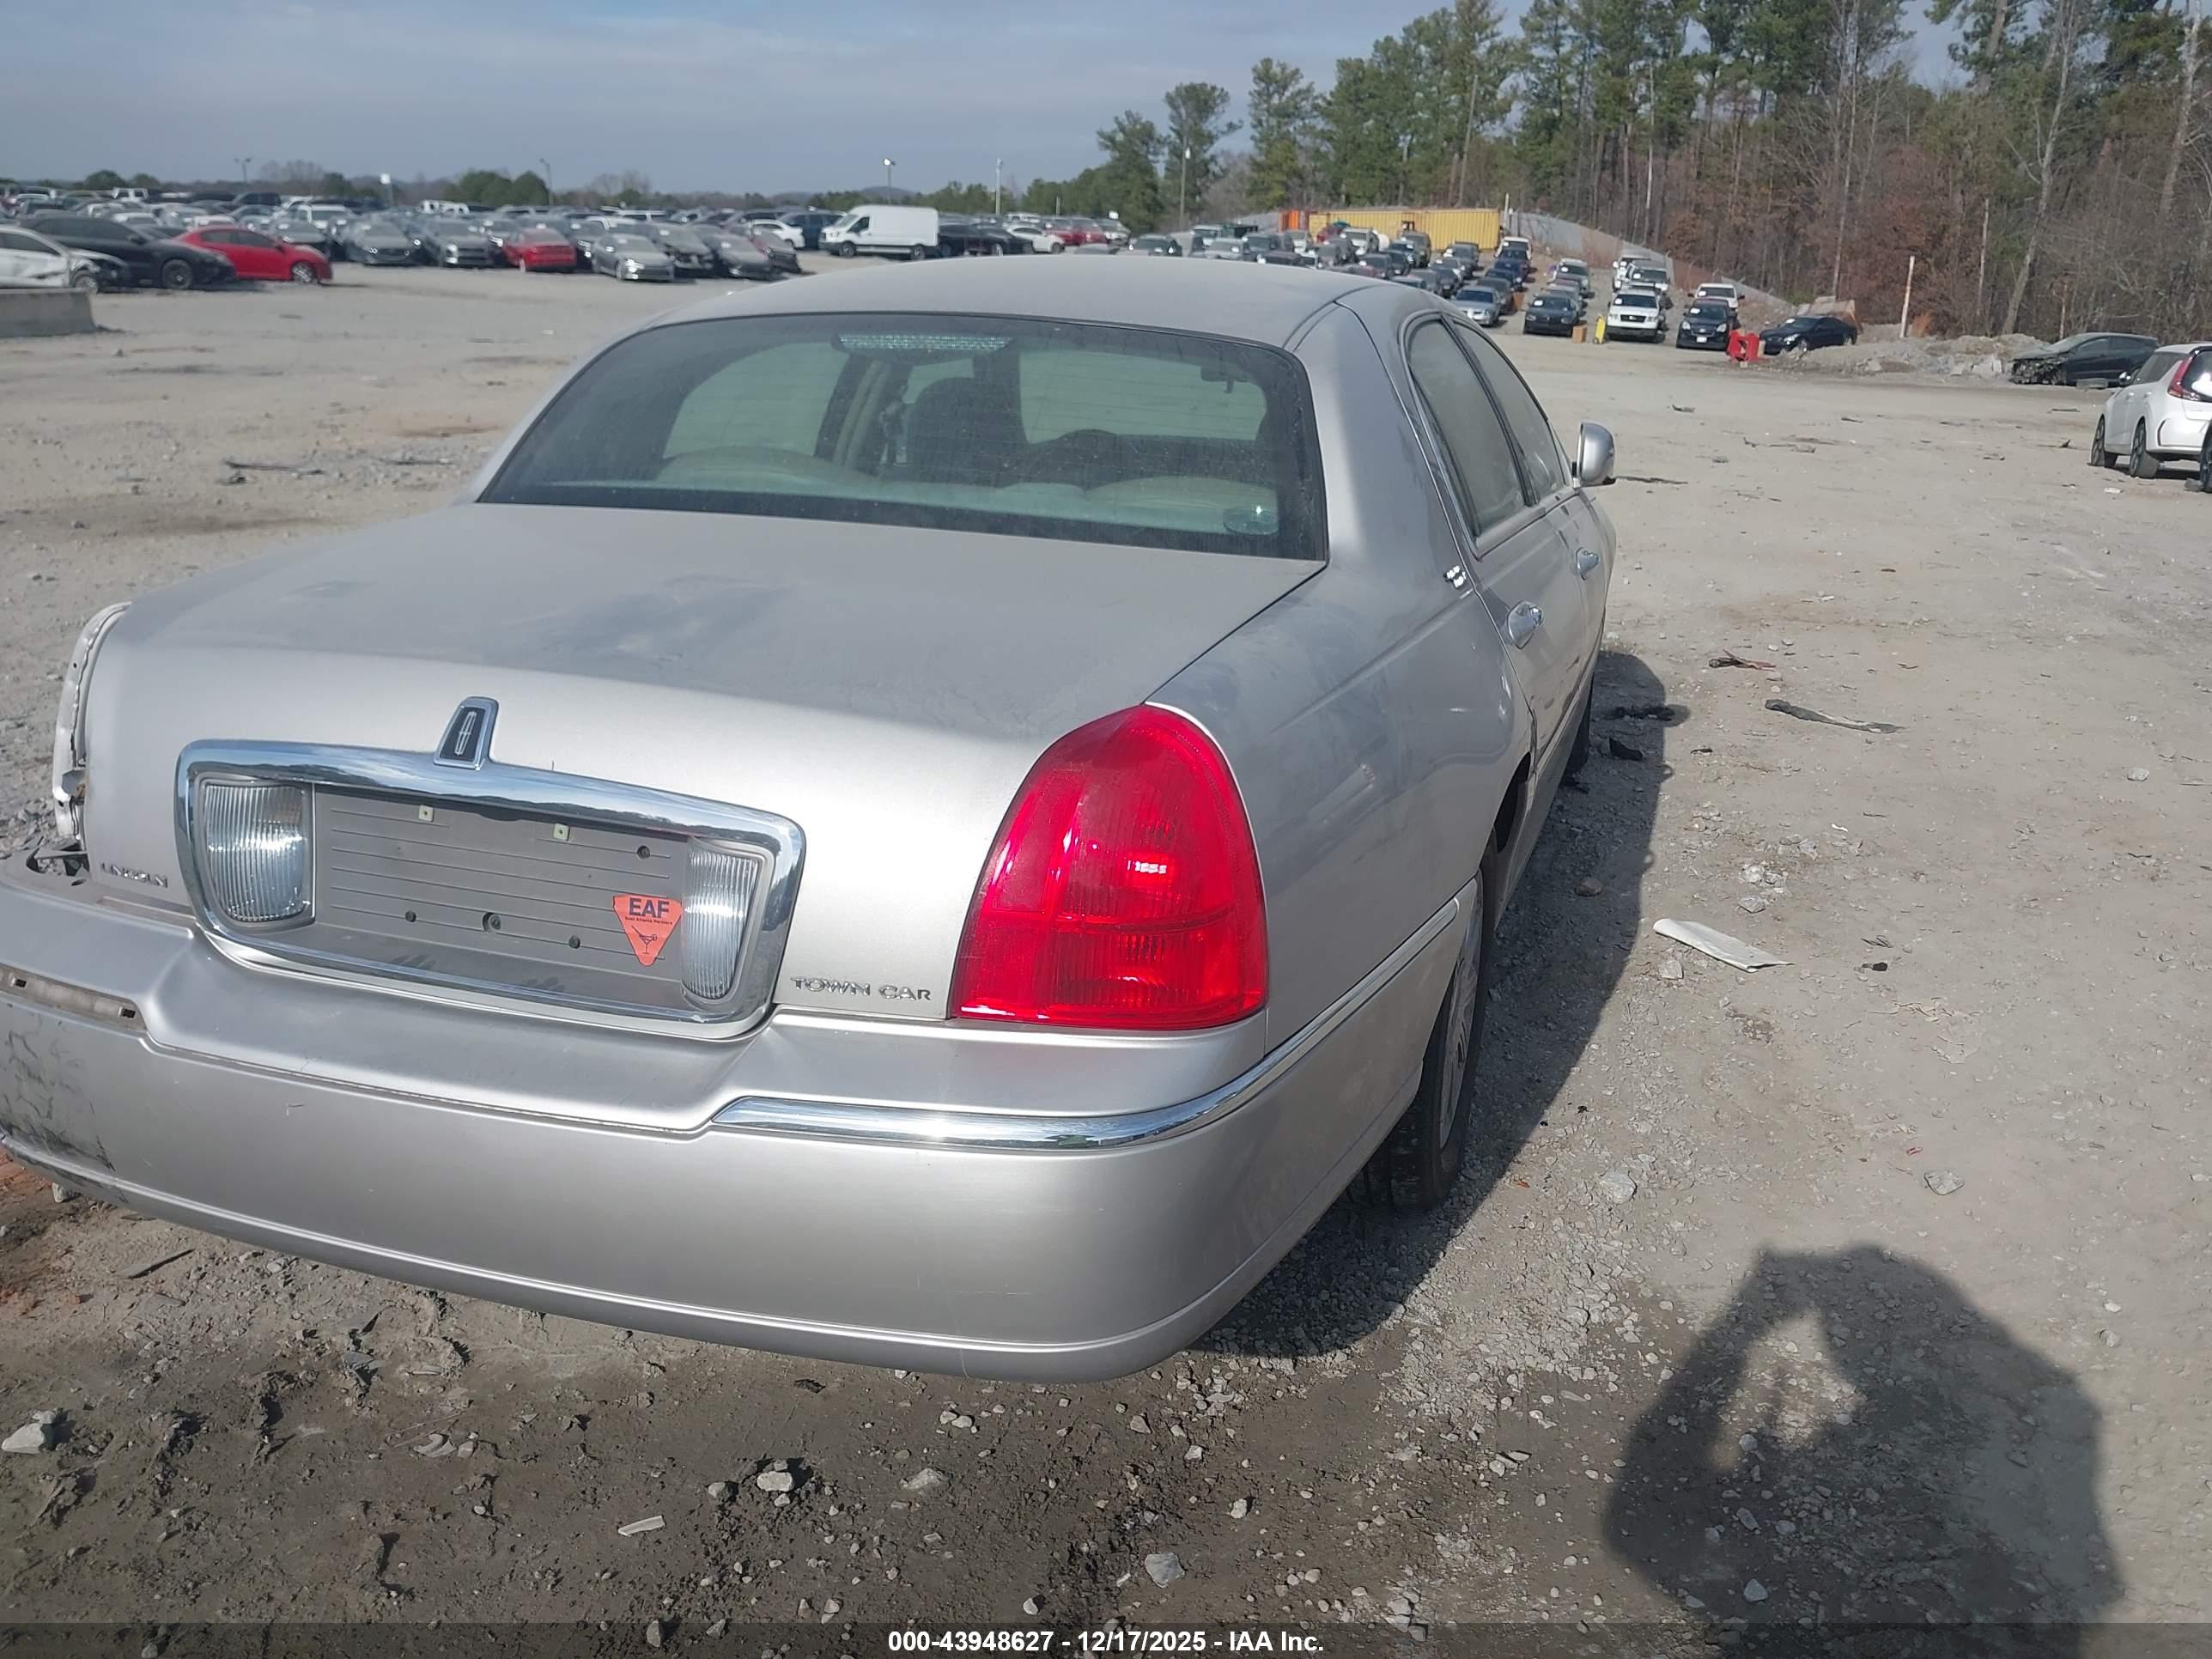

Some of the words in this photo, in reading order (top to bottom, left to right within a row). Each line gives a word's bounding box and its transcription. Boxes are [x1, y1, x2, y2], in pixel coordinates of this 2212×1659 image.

[629, 897, 670, 919] EAF
[790, 977, 871, 996] TOWN
[878, 984, 932, 1001] CAR
